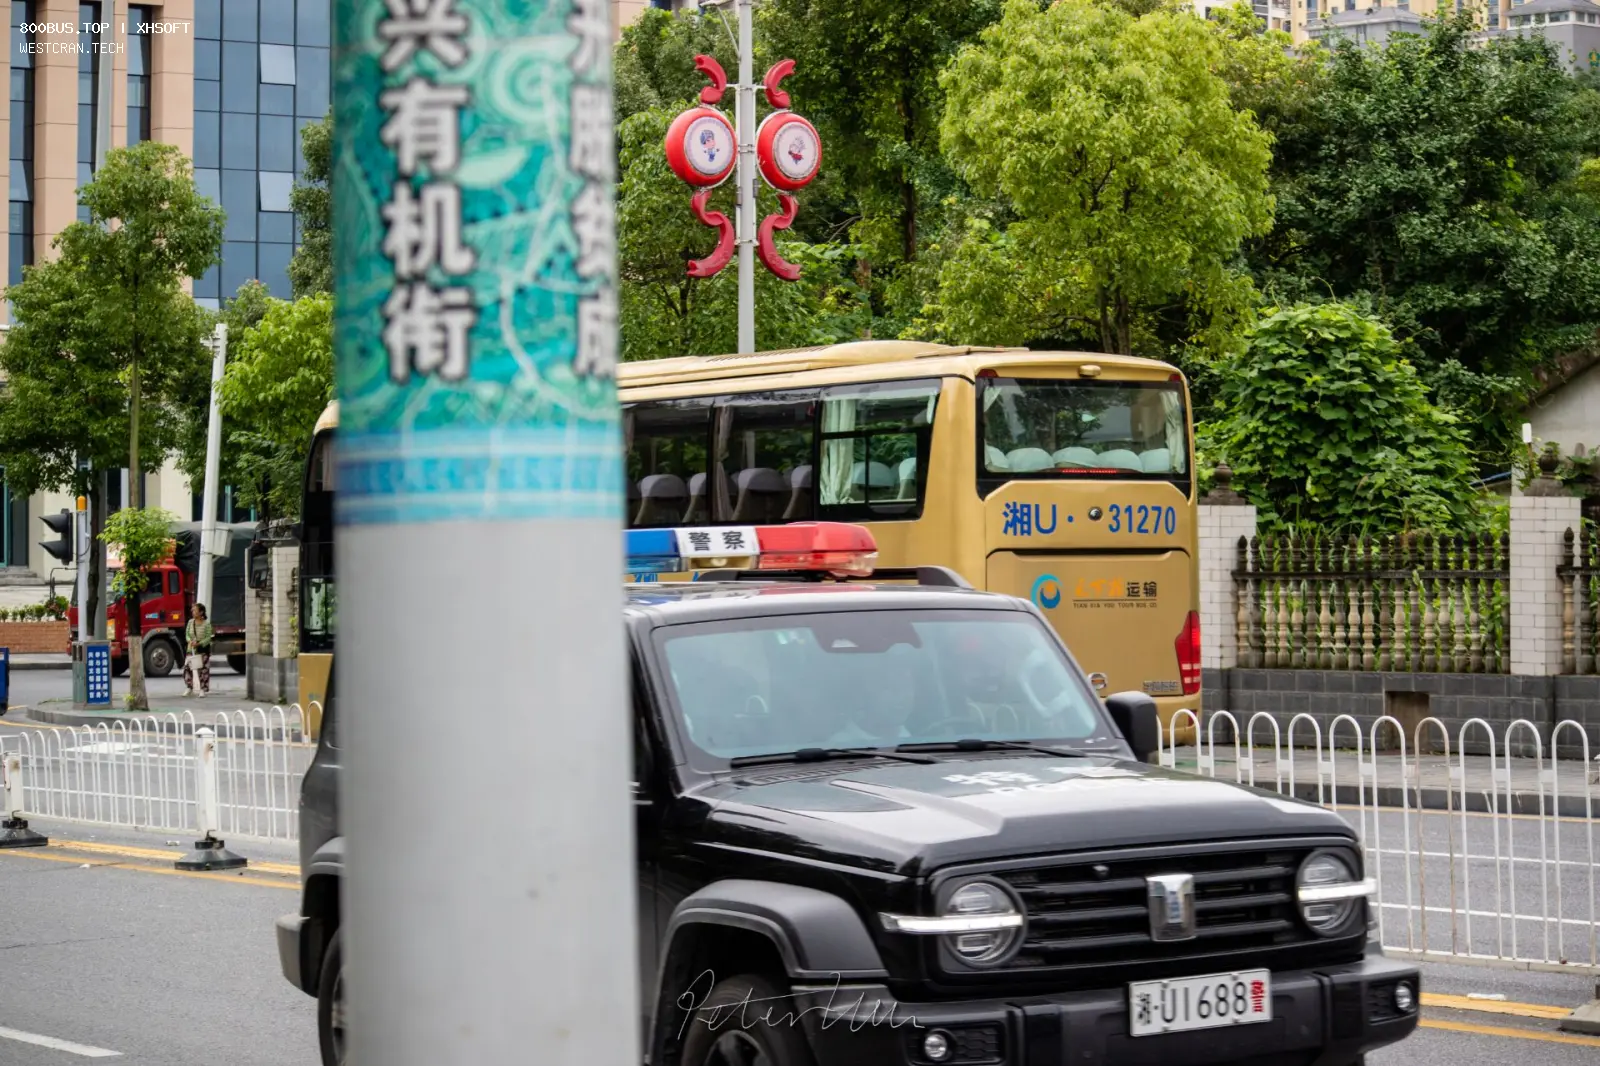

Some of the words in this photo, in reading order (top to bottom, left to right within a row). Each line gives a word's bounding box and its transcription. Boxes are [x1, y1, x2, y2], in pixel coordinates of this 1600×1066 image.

[1108, 503, 1176, 535] 31270
[688, 530, 744, 551] 警察
[1126, 581, 1157, 598] 运输
